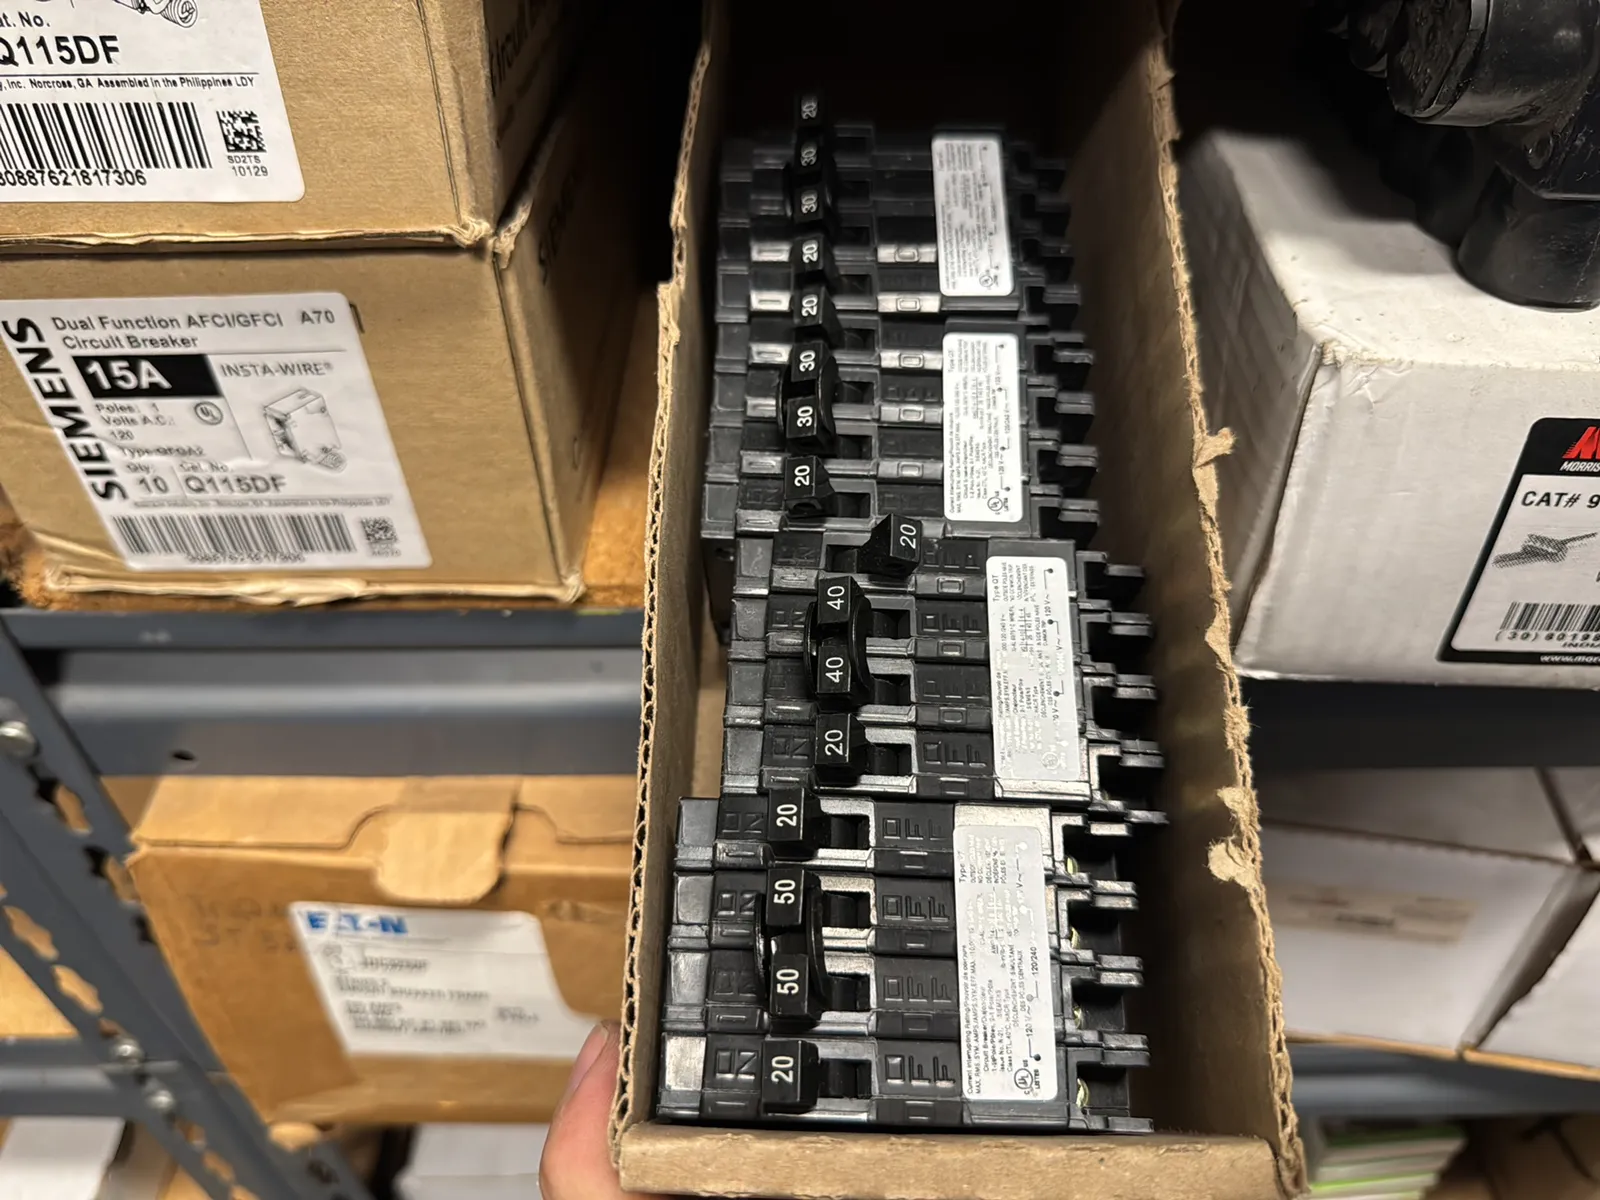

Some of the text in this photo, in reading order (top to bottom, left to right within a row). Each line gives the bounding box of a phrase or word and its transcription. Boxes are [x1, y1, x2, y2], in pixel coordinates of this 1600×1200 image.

[18, 11, 50, 27] No.
[0, 36, 119, 67] Q115DF
[97, 78, 149, 88] Assembled
[150, 77, 161, 87] in
[162, 77, 178, 87] the
[179, 77, 233, 89] Philippines
[235, 77, 254, 87] LDY
[801, 148, 817, 166] 30
[232, 165, 268, 176] 10129
[801, 193, 818, 213] 30
[802, 243, 819, 264] 20
[802, 294, 819, 317] 20
[51, 310, 335, 331] Dual Function AFCI/GFCI A70
[63, 335, 199, 349] Circuit Breaker
[799, 350, 816, 372] 30
[85, 359, 172, 390] 15A
[1, 317, 129, 500] SIEMENS
[797, 405, 813, 427] 30
[139, 476, 169, 494] 10
[185, 474, 286, 494] Q115DF
[794, 465, 810, 487] 20
[1521, 490, 1581, 507] CAT#
[899, 523, 917, 549] 20
[827, 585, 845, 611] 40
[826, 656, 844, 683] 40
[825, 729, 843, 757] 20
[776, 803, 798, 827] 20
[773, 879, 796, 905] 50
[1030, 946, 1038, 976] 120/240
[776, 968, 799, 995] 50
[771, 1055, 794, 1084] 20
